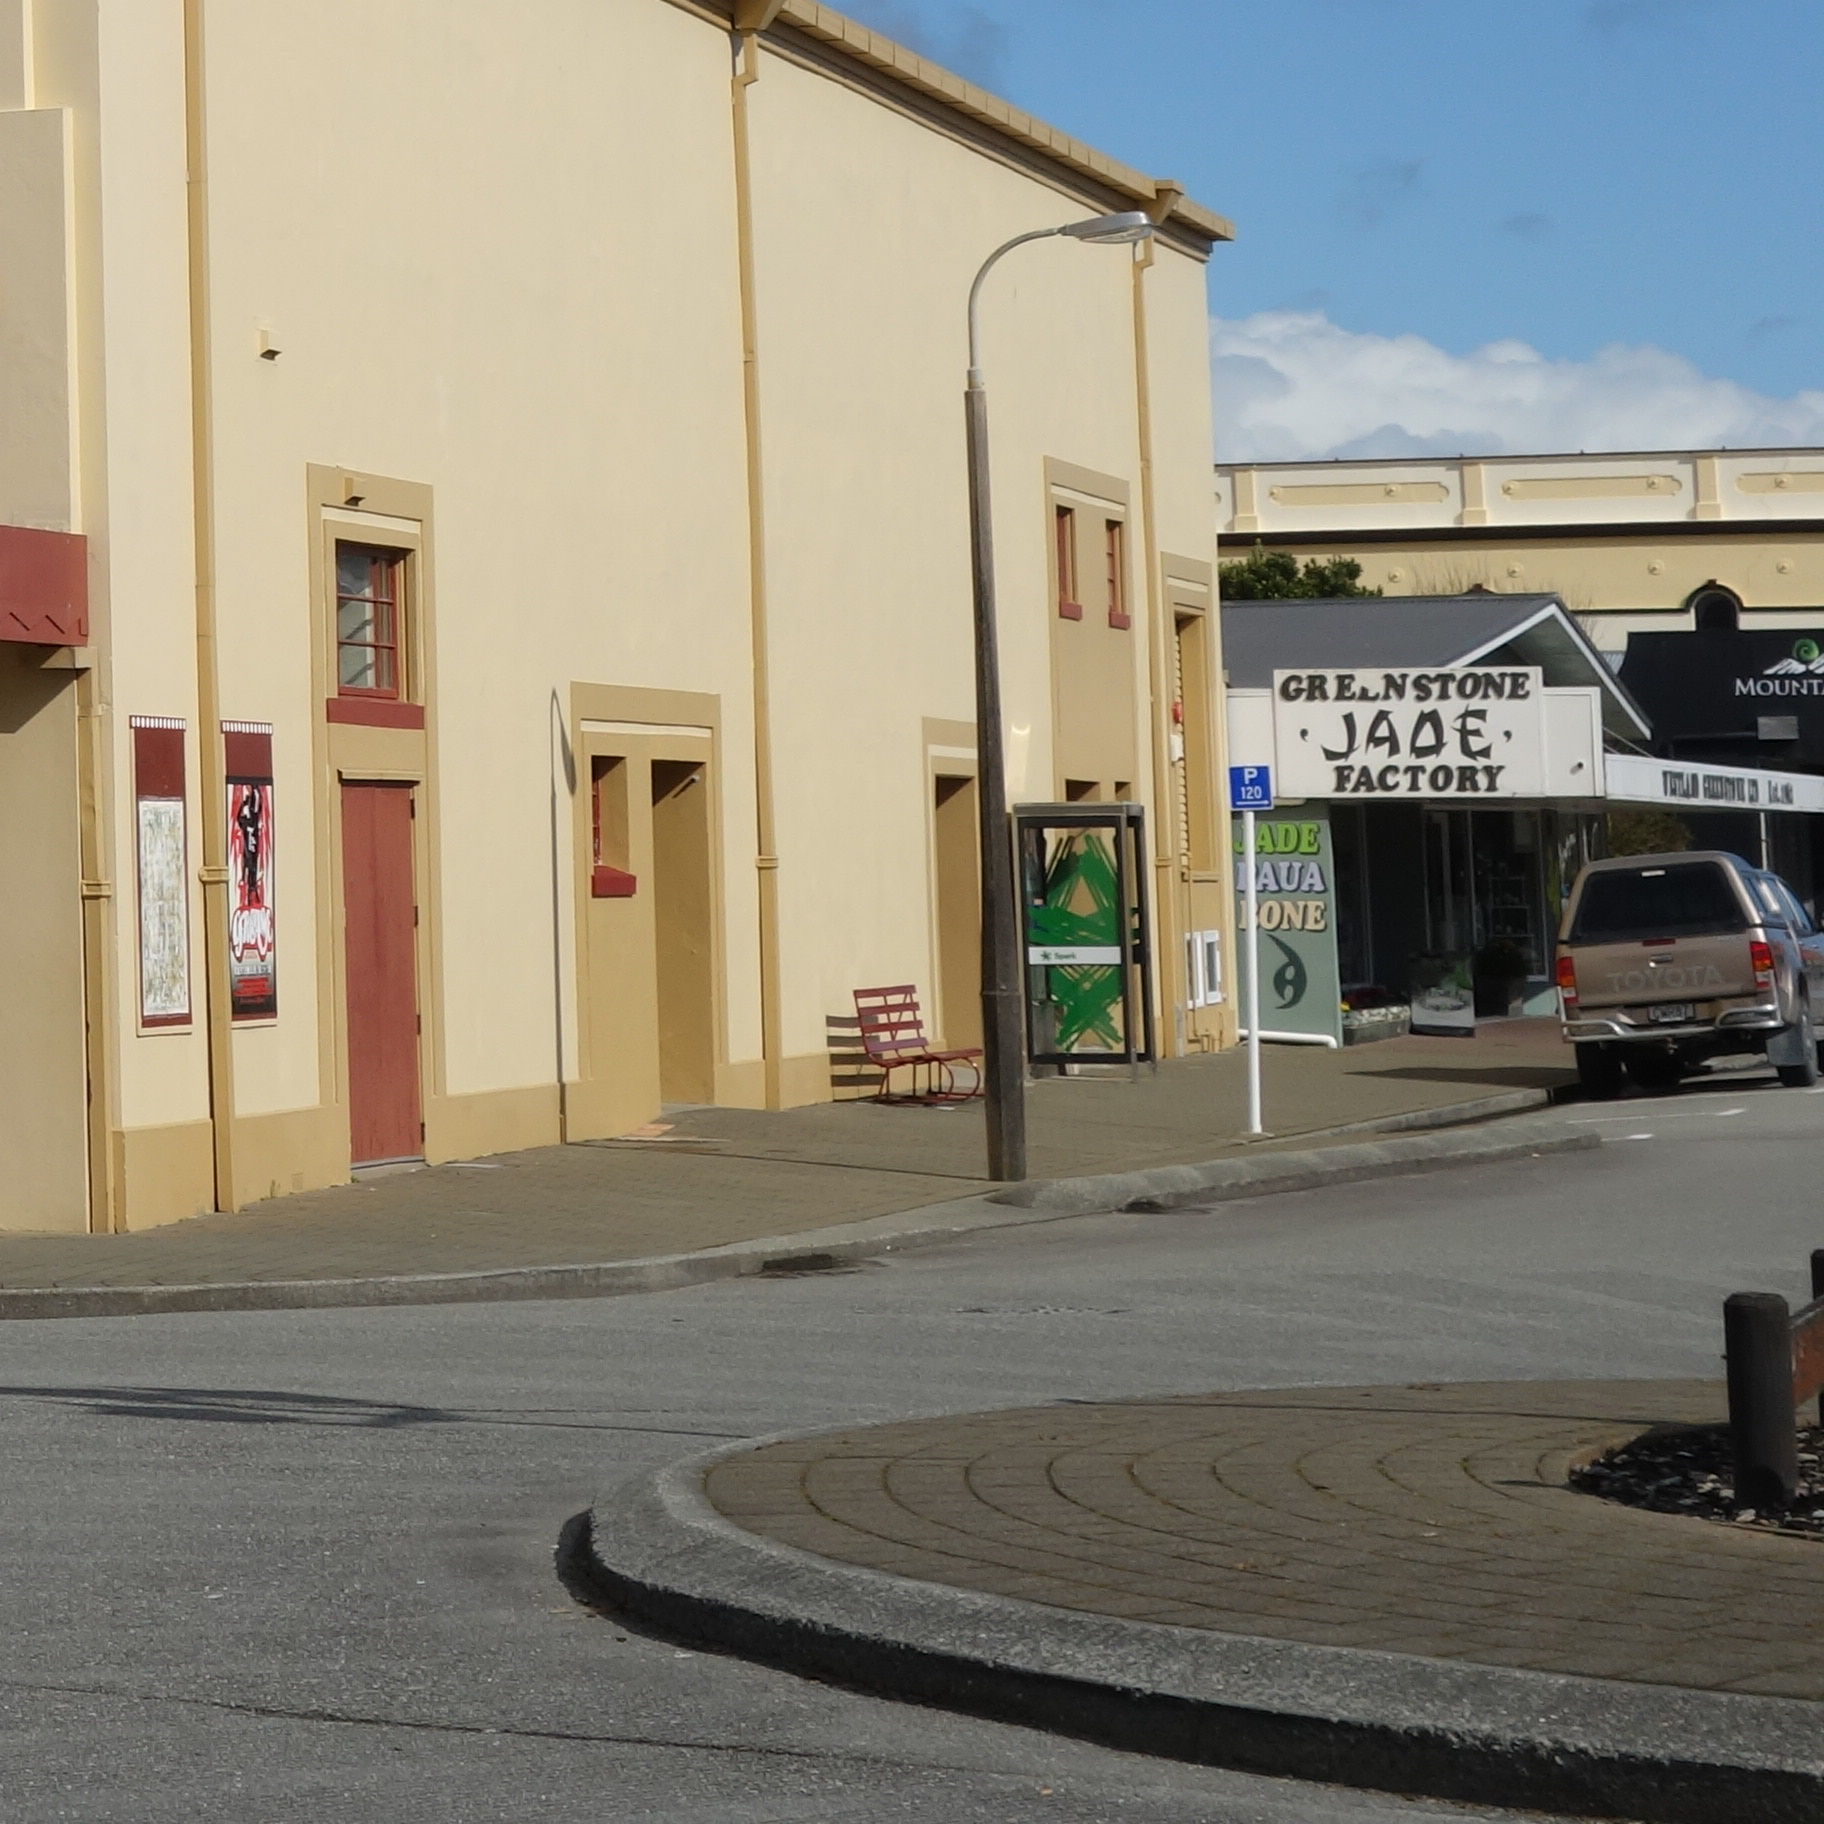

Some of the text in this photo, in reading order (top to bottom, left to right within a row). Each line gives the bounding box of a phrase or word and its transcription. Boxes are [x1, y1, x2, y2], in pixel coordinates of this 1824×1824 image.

[1735, 677, 1824, 696] MOUNT
[1321, 703, 1493, 762] JADE
[1243, 768, 1258, 784] P
[1333, 764, 1505, 793] FACTORY
[1240, 786, 1262, 800] 120
[1606, 965, 1724, 991] TOYOTA
